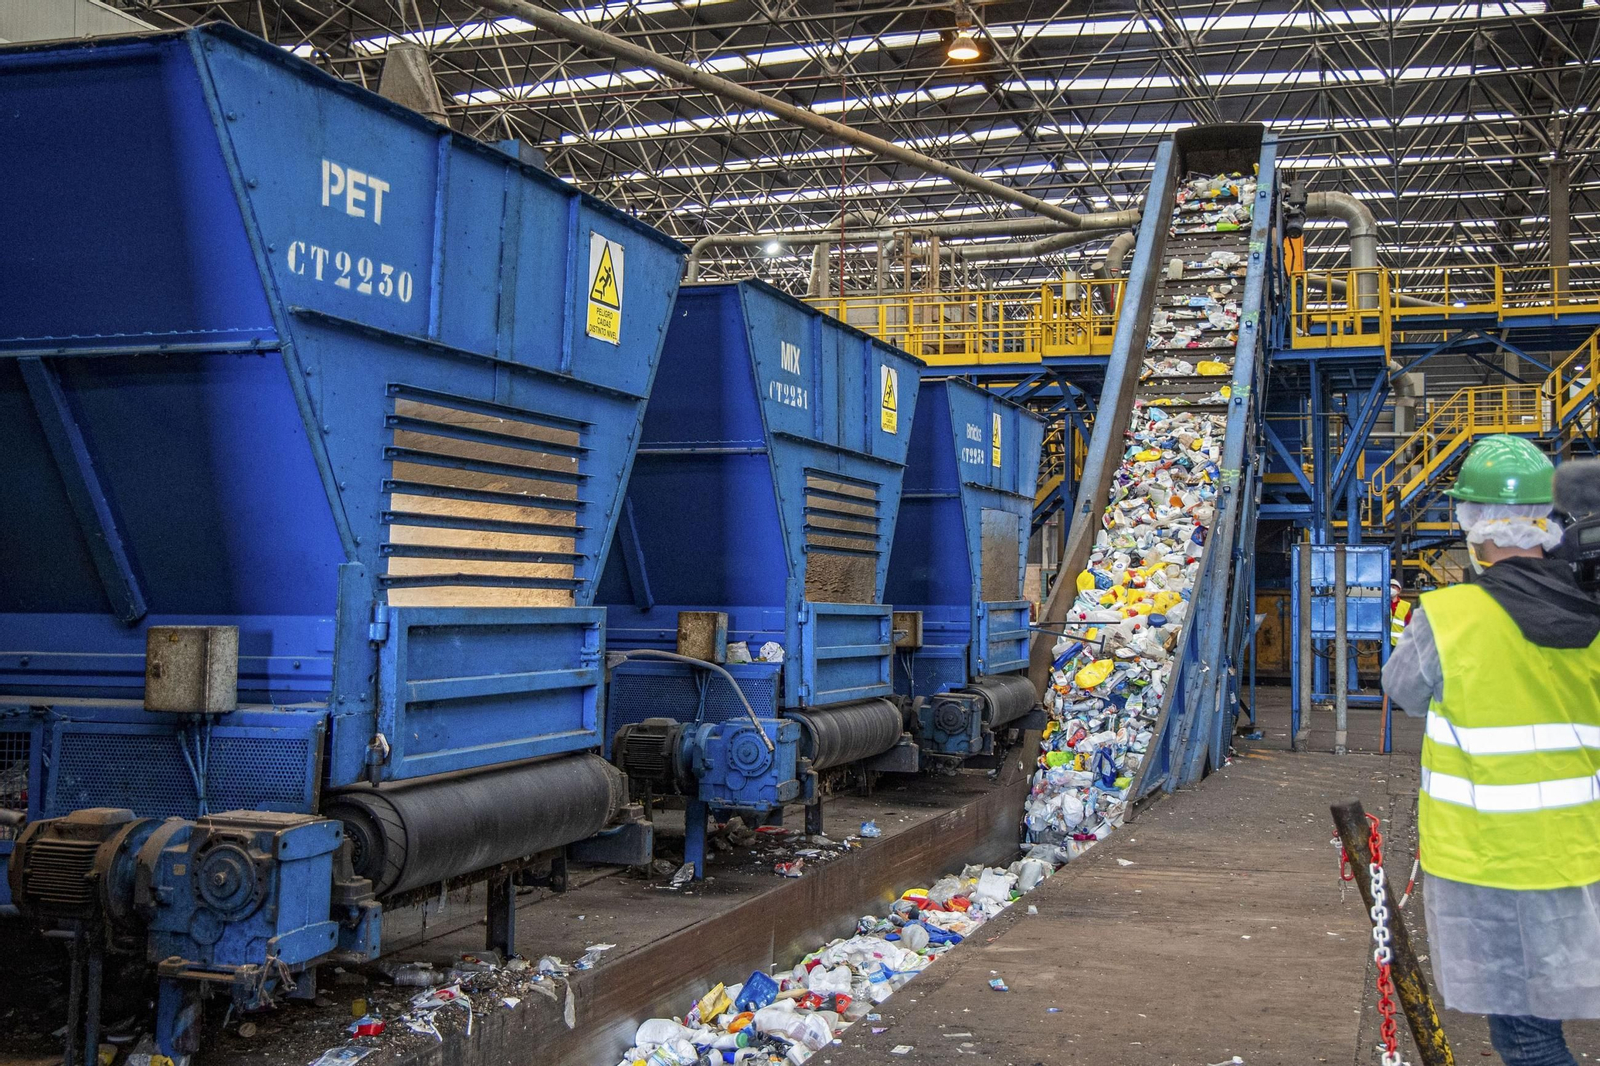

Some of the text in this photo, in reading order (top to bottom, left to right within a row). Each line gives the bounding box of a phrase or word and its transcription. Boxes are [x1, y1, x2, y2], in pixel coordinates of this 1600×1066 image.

[322, 159, 390, 226] PET
[287, 240, 413, 303] CT2230
[781, 340, 801, 375] MIX
[769, 380, 808, 410] CT2231
